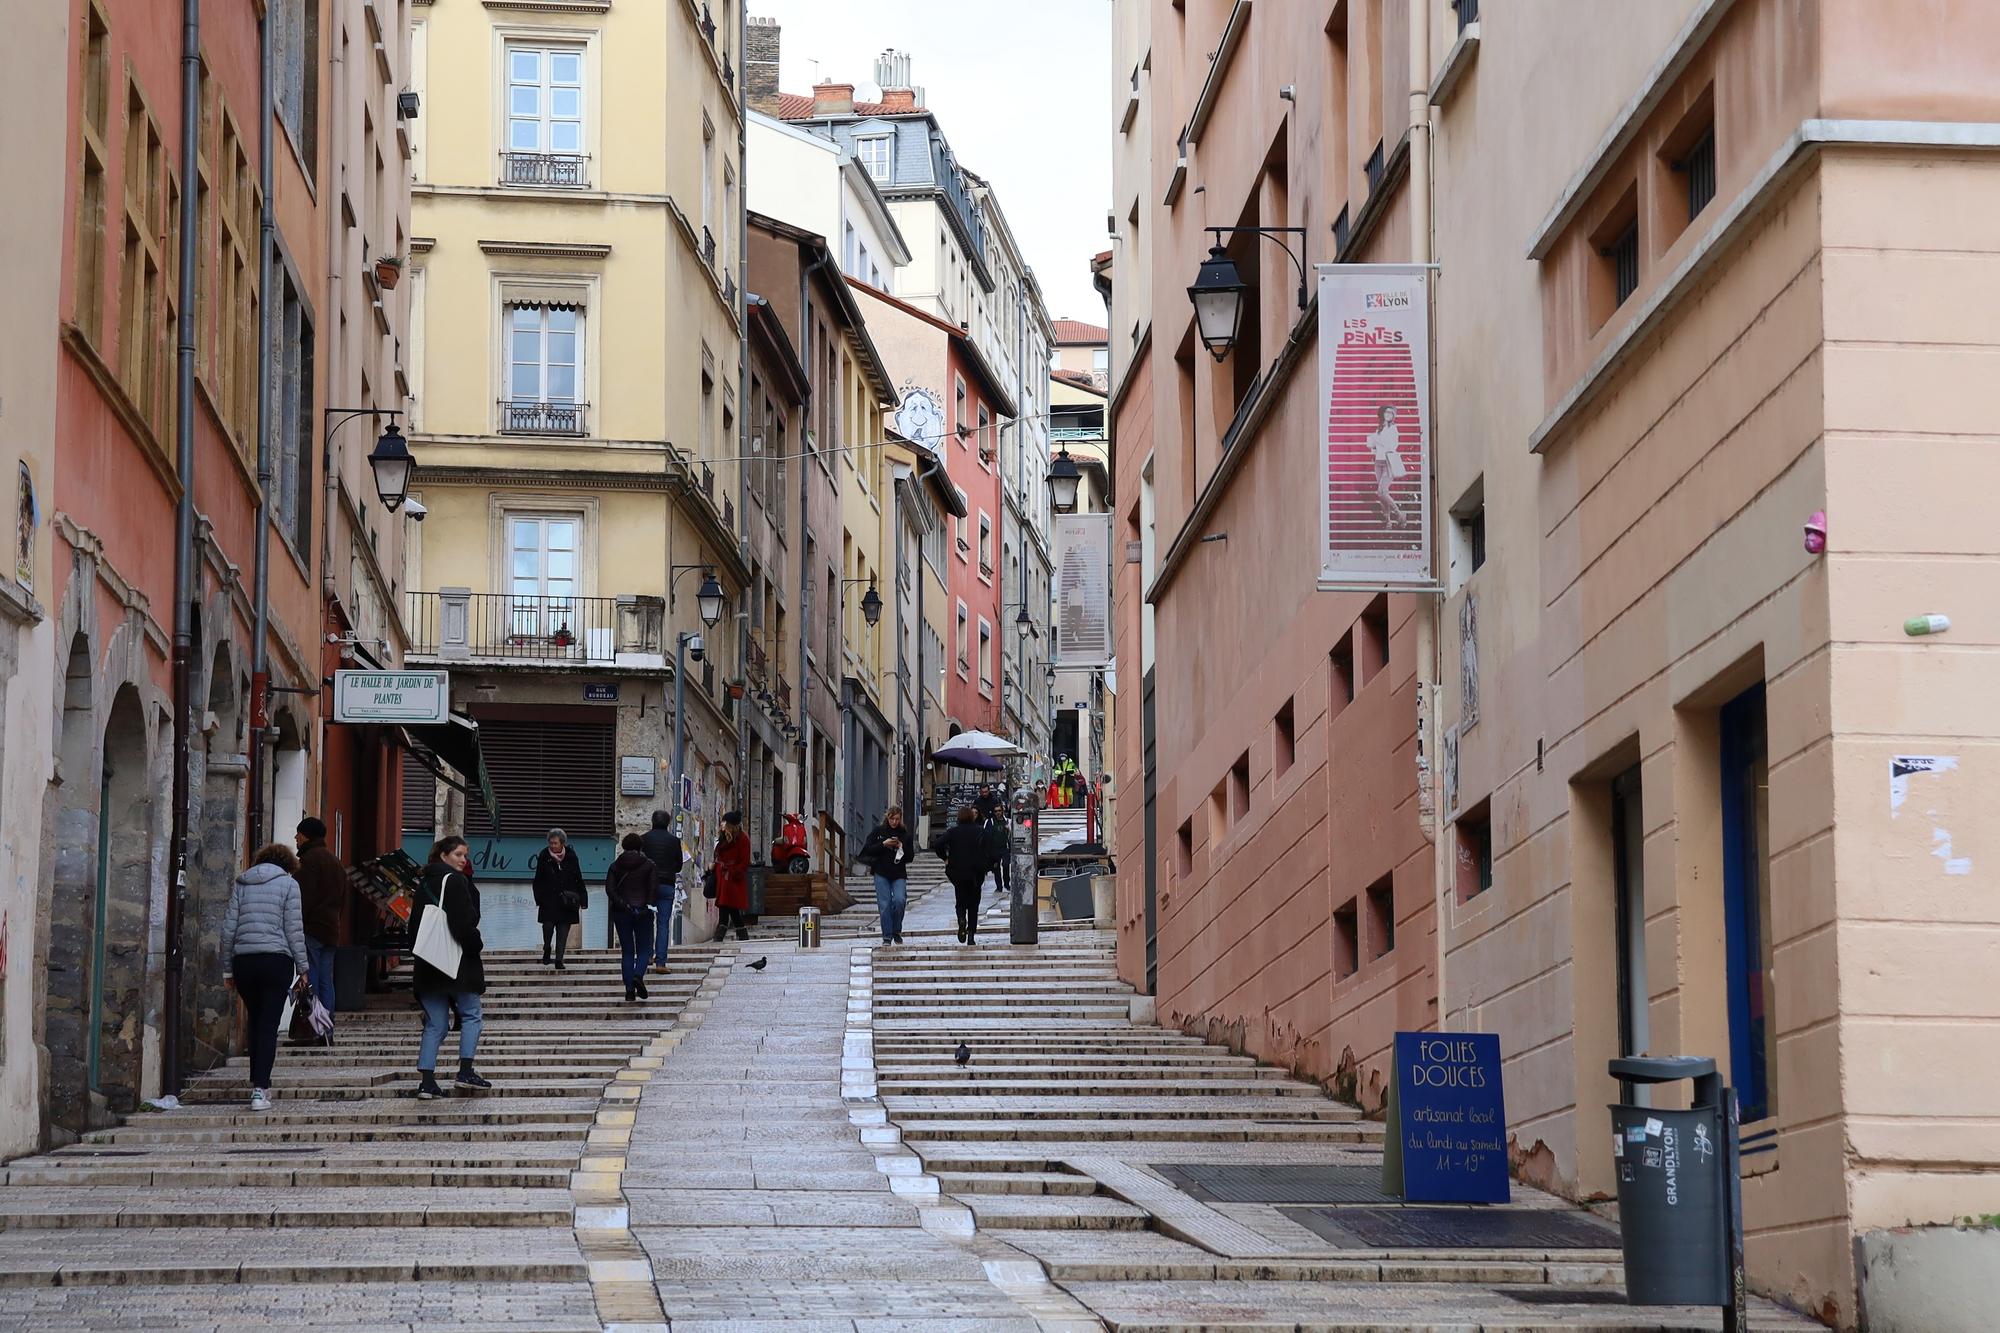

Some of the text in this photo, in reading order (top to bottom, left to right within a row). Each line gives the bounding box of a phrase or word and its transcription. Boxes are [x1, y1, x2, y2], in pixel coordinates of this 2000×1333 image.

[1383, 297, 1409, 307] LYON
[1344, 319, 1367, 328] LES
[1344, 326, 1404, 345] PENTES
[351, 677, 434, 690] LE HALLE DE JARDIN DE
[373, 693, 403, 705] PLANTES
[473, 839, 513, 871] du
[1420, 1040, 1477, 1063] FOLIES
[1412, 1064, 1486, 1088] DOUCES
[1413, 1105, 1496, 1124] artisanat local
[1408, 1130, 1502, 1152] du lundi au samedi
[1436, 1154, 1450, 1171] 11
[1663, 1127, 1677, 1205] GRANDLYON
